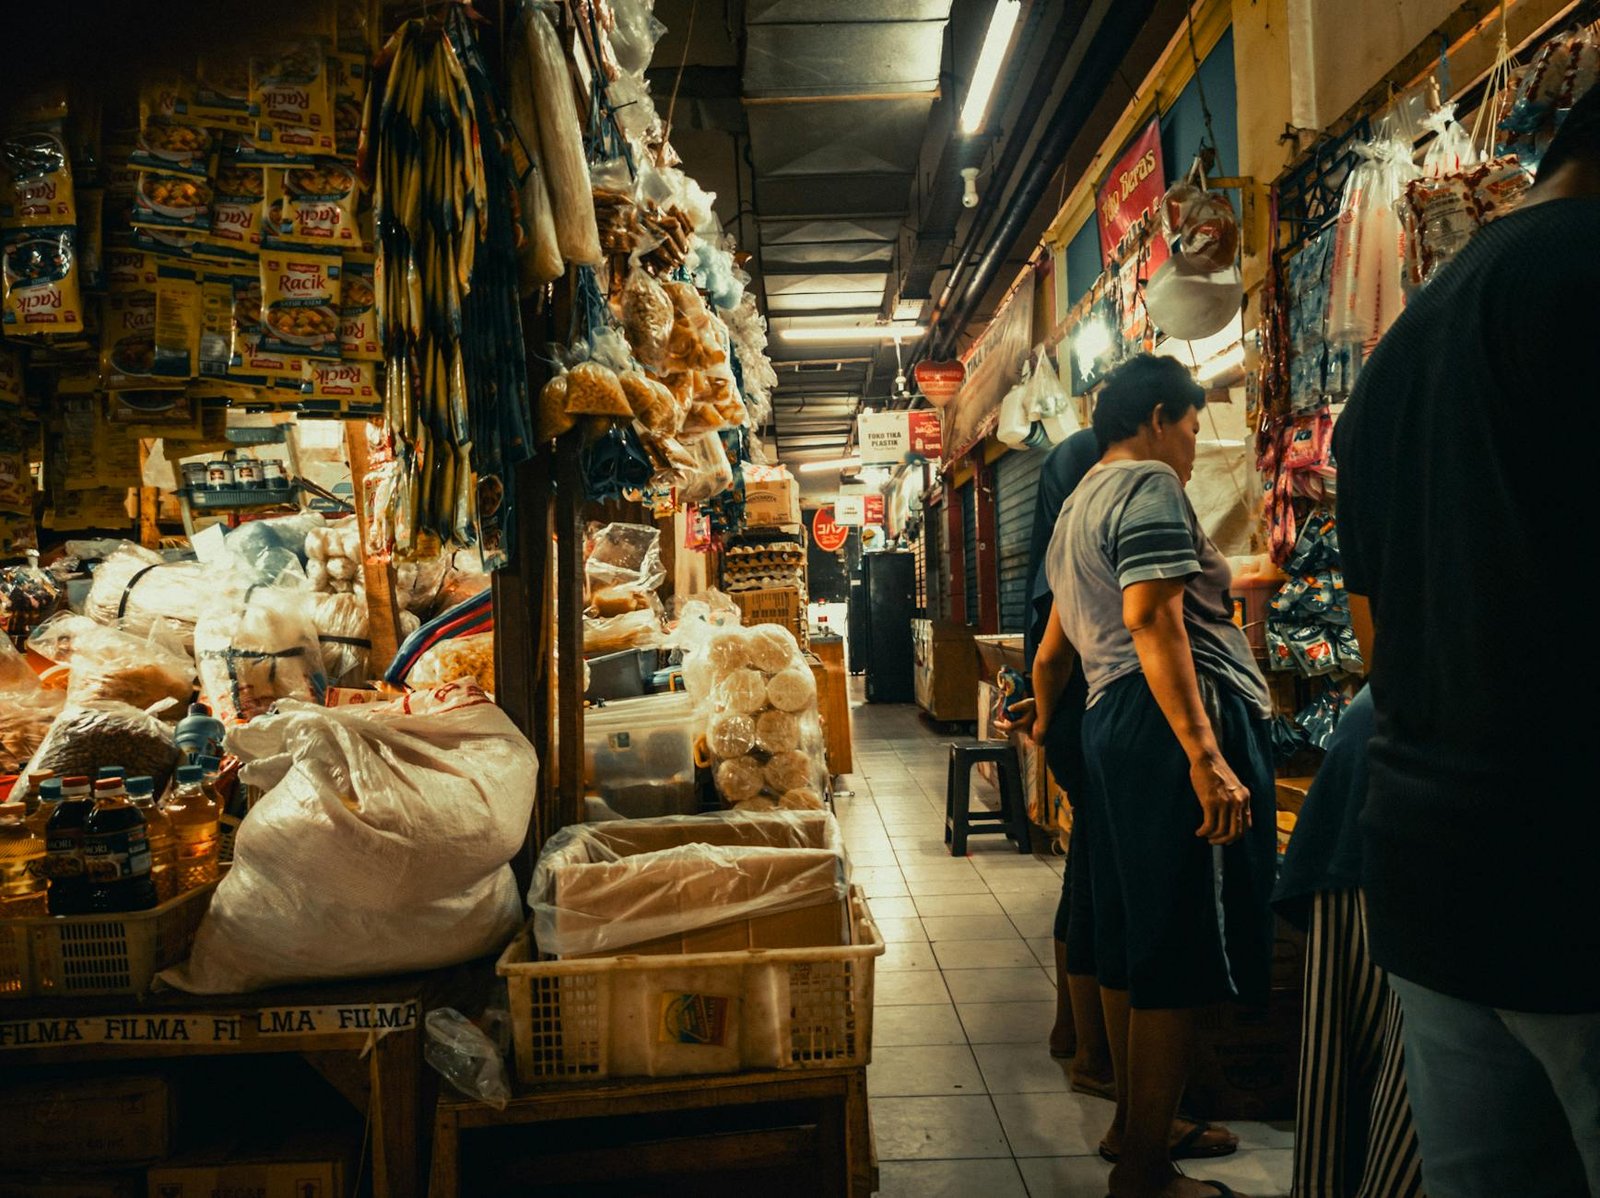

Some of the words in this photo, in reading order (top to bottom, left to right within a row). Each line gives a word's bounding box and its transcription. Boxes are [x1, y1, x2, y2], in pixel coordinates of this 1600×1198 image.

[261, 91, 310, 109] Racik
[1119, 149, 1156, 201] Beras
[215, 207, 253, 228] Raci
[295, 207, 341, 226] Racik
[278, 274, 326, 292] Racik
[17, 289, 62, 314] Racik
[122, 311, 156, 329] Rac
[315, 367, 361, 384] Racik
[871, 439, 898, 447] PLASTIK
[886, 431, 902, 439] TIKA
[337, 1004, 417, 1029] FILMA
[0, 1020, 83, 1045] FILMA
[104, 1019, 190, 1040] FILMA
[212, 1019, 239, 1041] FI
